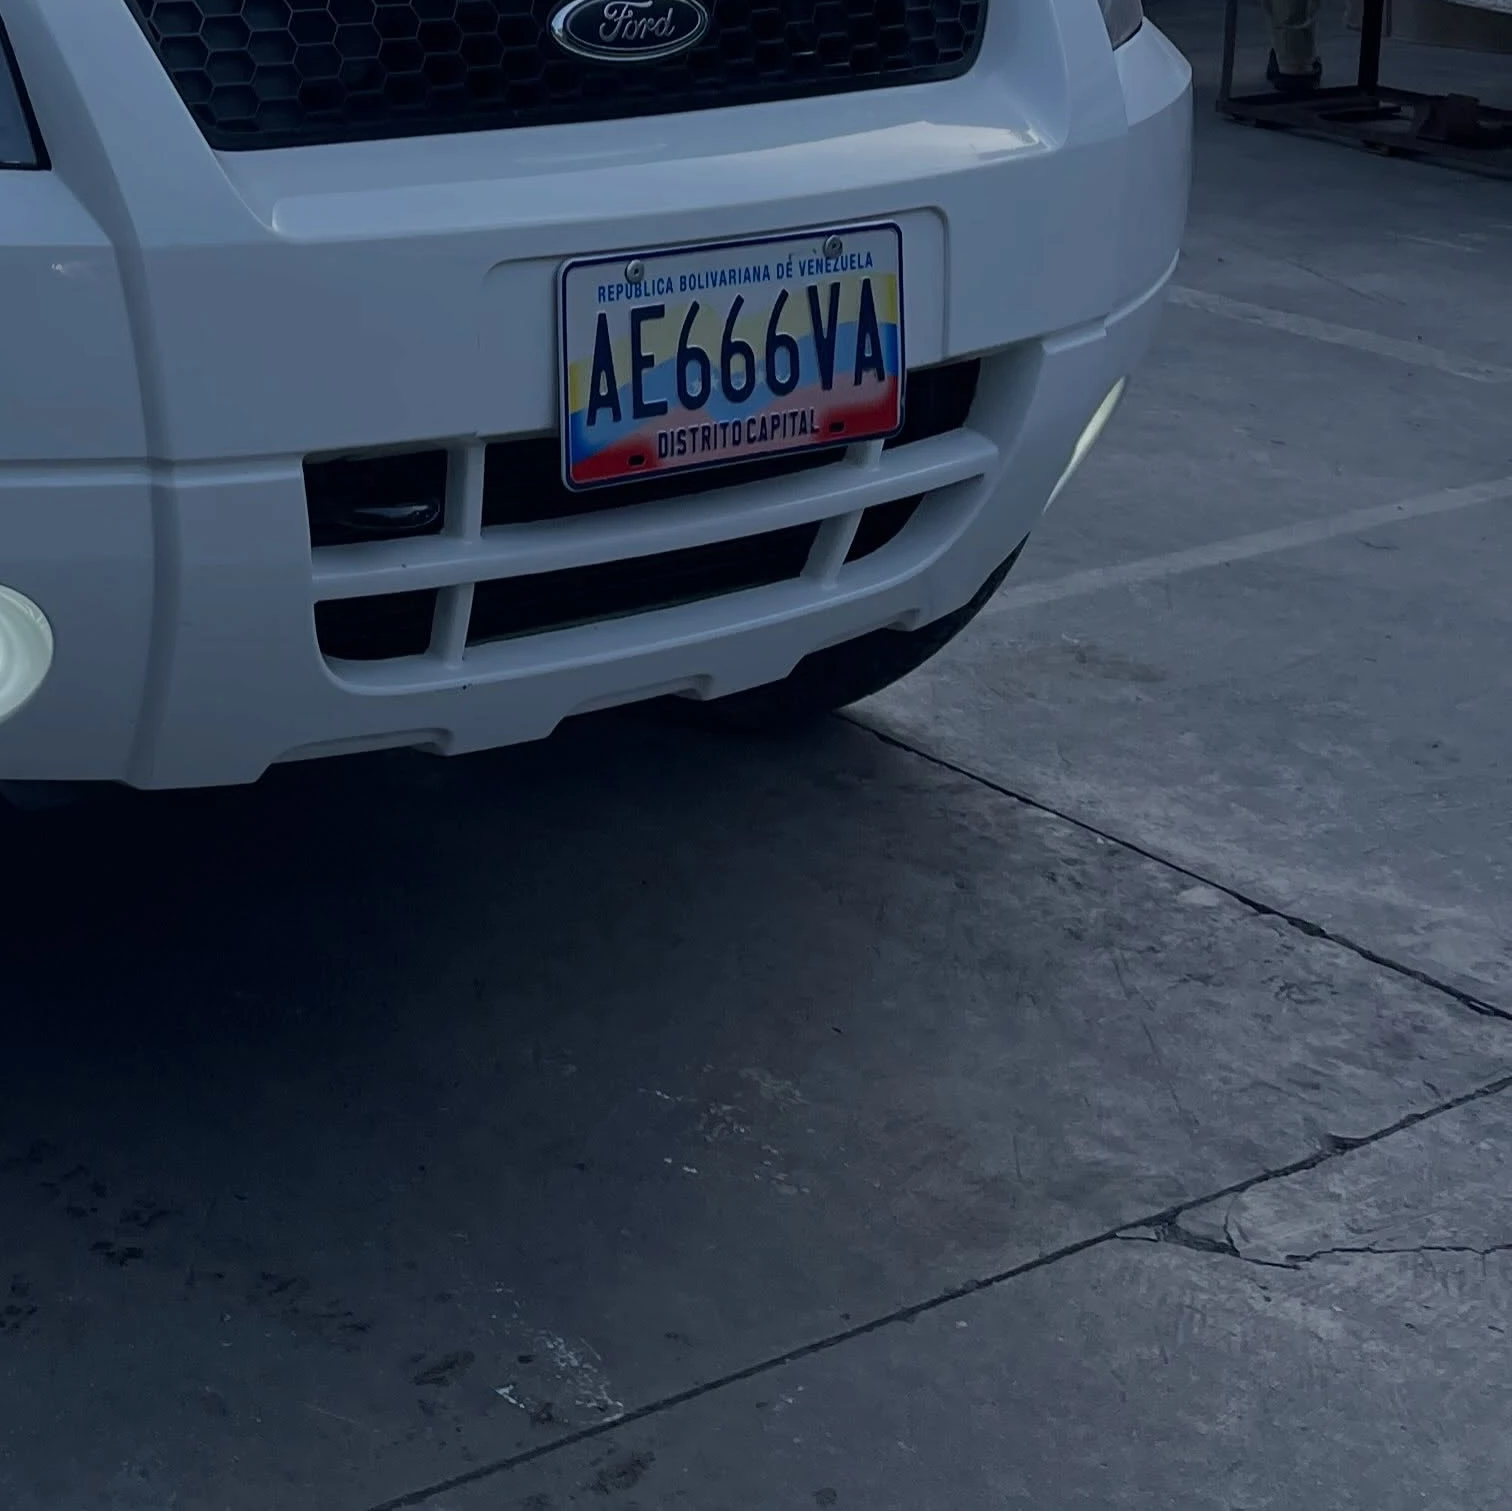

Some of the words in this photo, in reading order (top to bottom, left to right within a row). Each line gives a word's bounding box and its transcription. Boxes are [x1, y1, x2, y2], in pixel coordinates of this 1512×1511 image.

[599, 0, 675, 42] Ford
[680, 265, 771, 292] BOLIVARIANA
[798, 251, 873, 277] VENEZUELA
[586, 277, 886, 427] AE666VA
